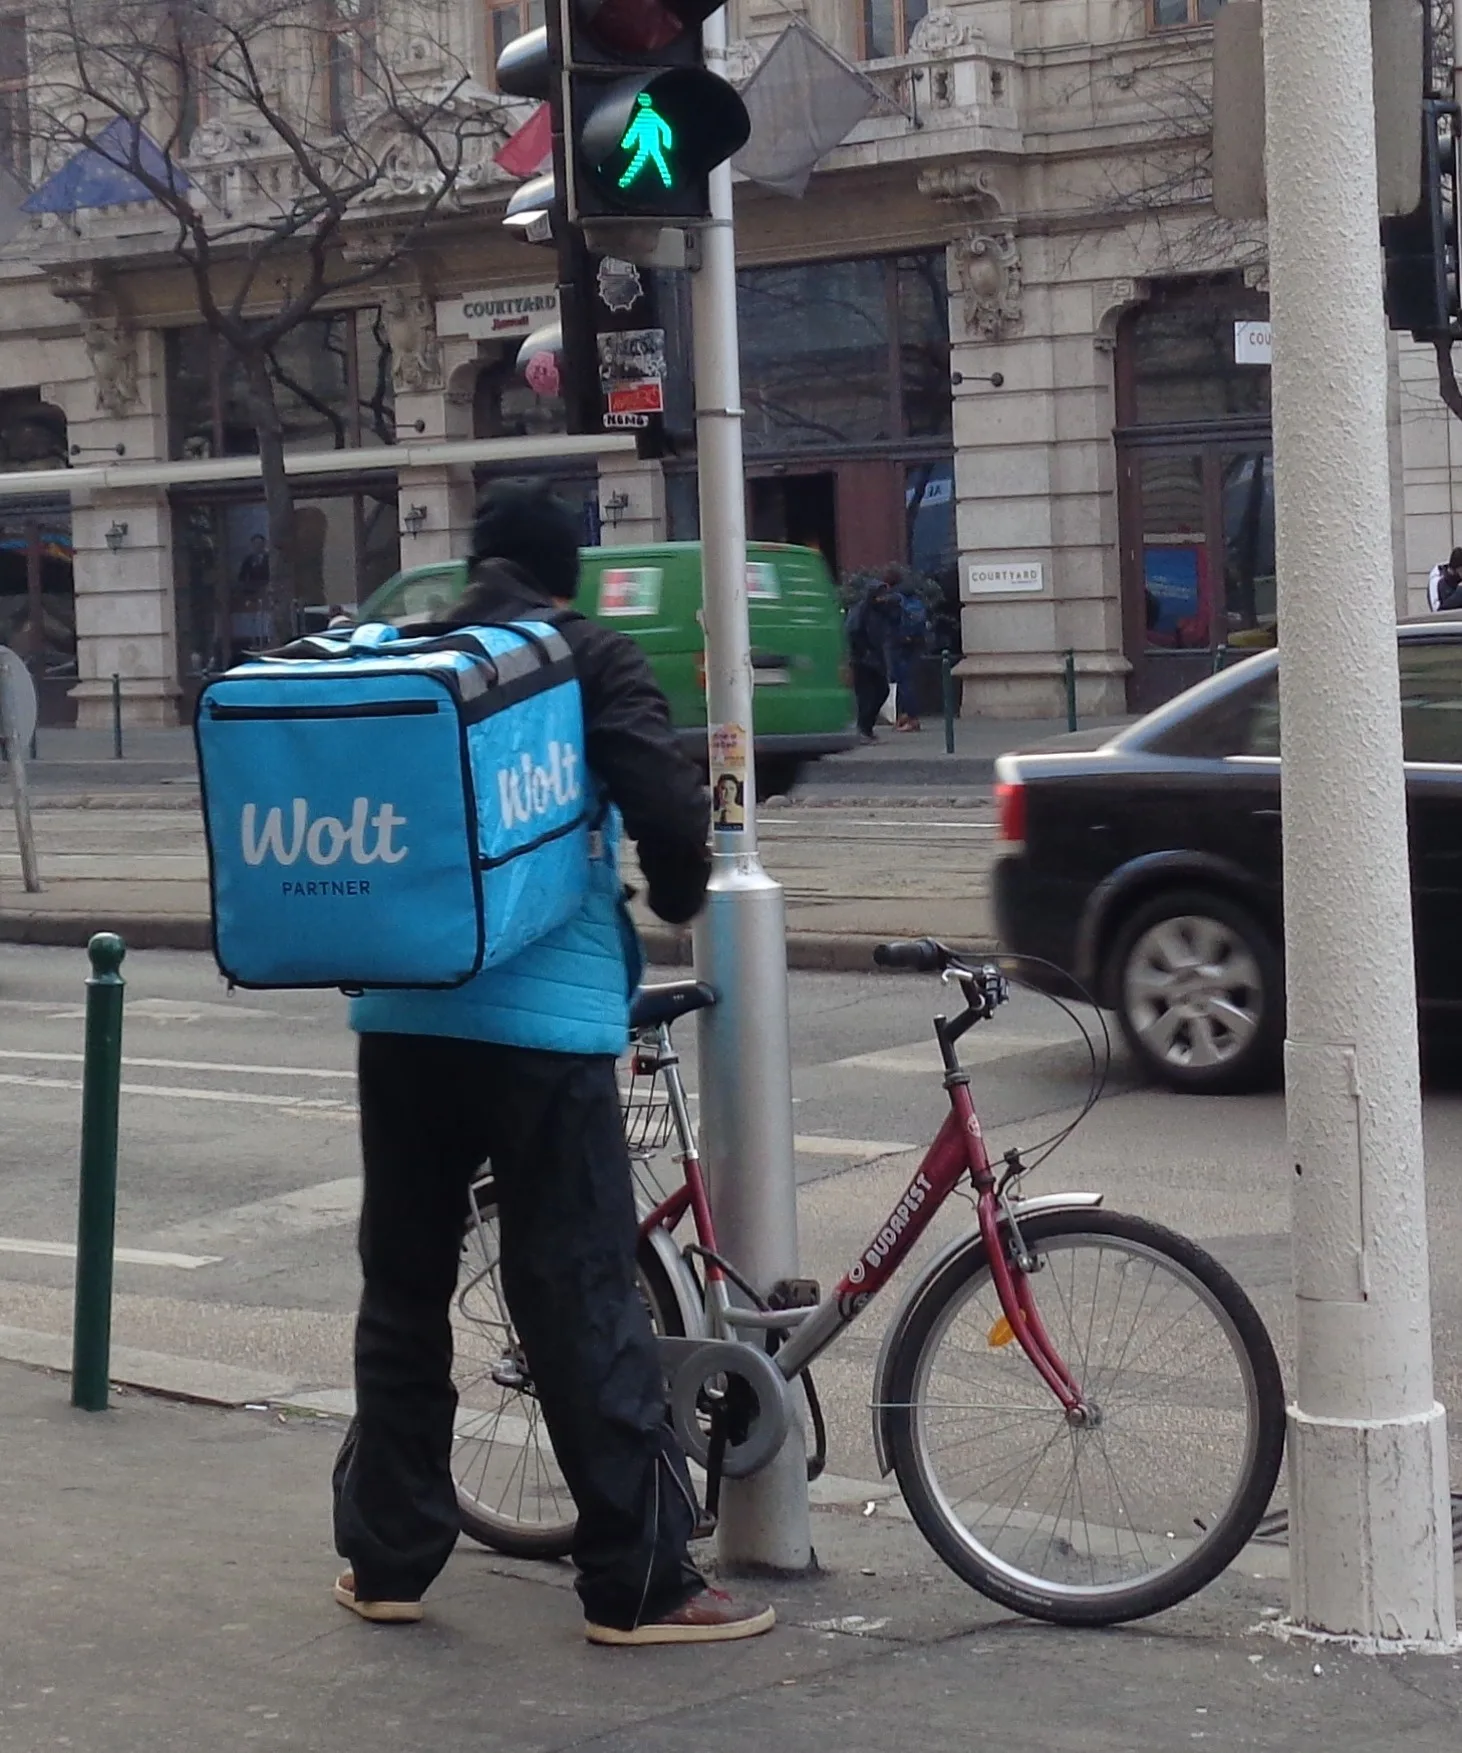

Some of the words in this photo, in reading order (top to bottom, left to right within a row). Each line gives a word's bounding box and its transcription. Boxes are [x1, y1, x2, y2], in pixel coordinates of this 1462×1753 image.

[463, 295, 556, 318] COURTYARD
[1249, 332, 1271, 345] COU
[971, 569, 1037, 582] COURTYARD
[497, 741, 580, 829] Wolt
[241, 797, 409, 865] Wolt
[281, 879, 371, 897] PARTNER
[865, 1172, 932, 1268] BUDAPEST
